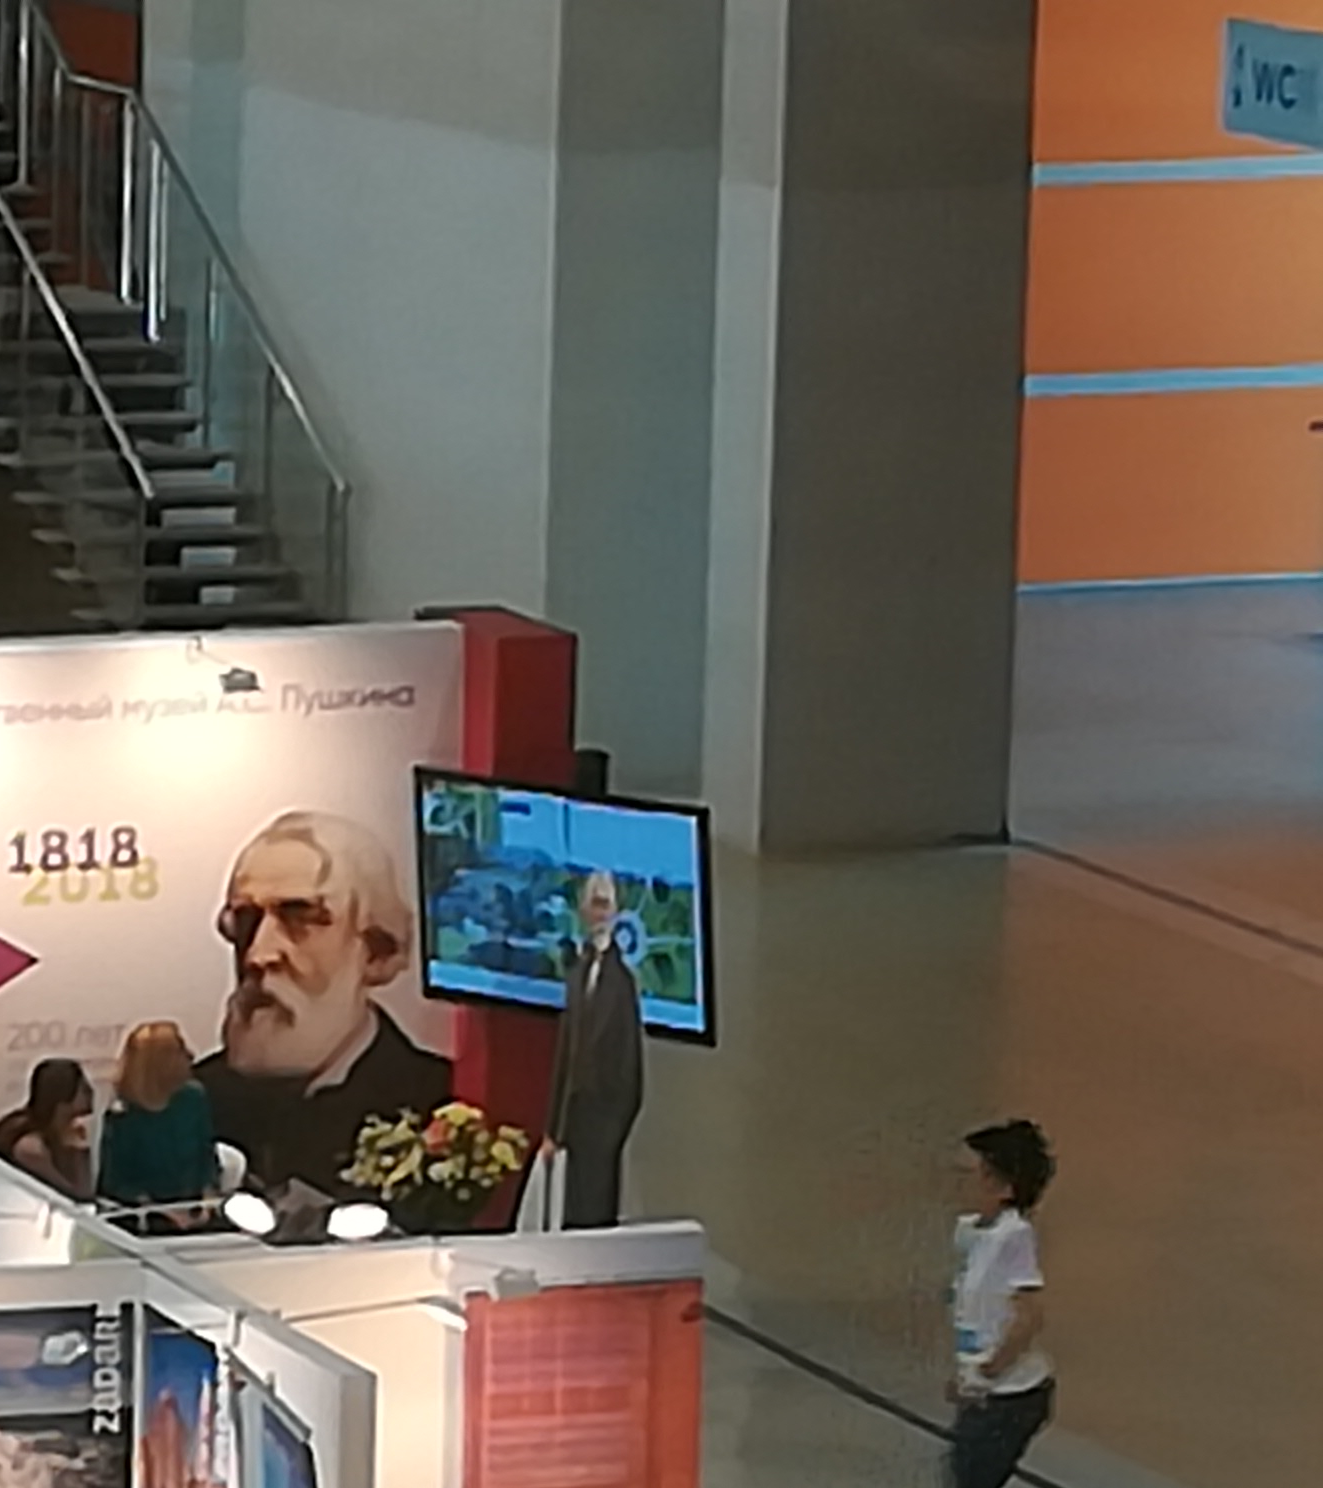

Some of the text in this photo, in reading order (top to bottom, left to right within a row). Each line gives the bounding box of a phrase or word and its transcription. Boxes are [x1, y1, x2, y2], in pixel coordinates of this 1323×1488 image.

[1252, 58, 1299, 109] WC
[281, 683, 415, 717] Пушкина
[8, 826, 140, 874] 1818
[22, 855, 160, 906] 2018
